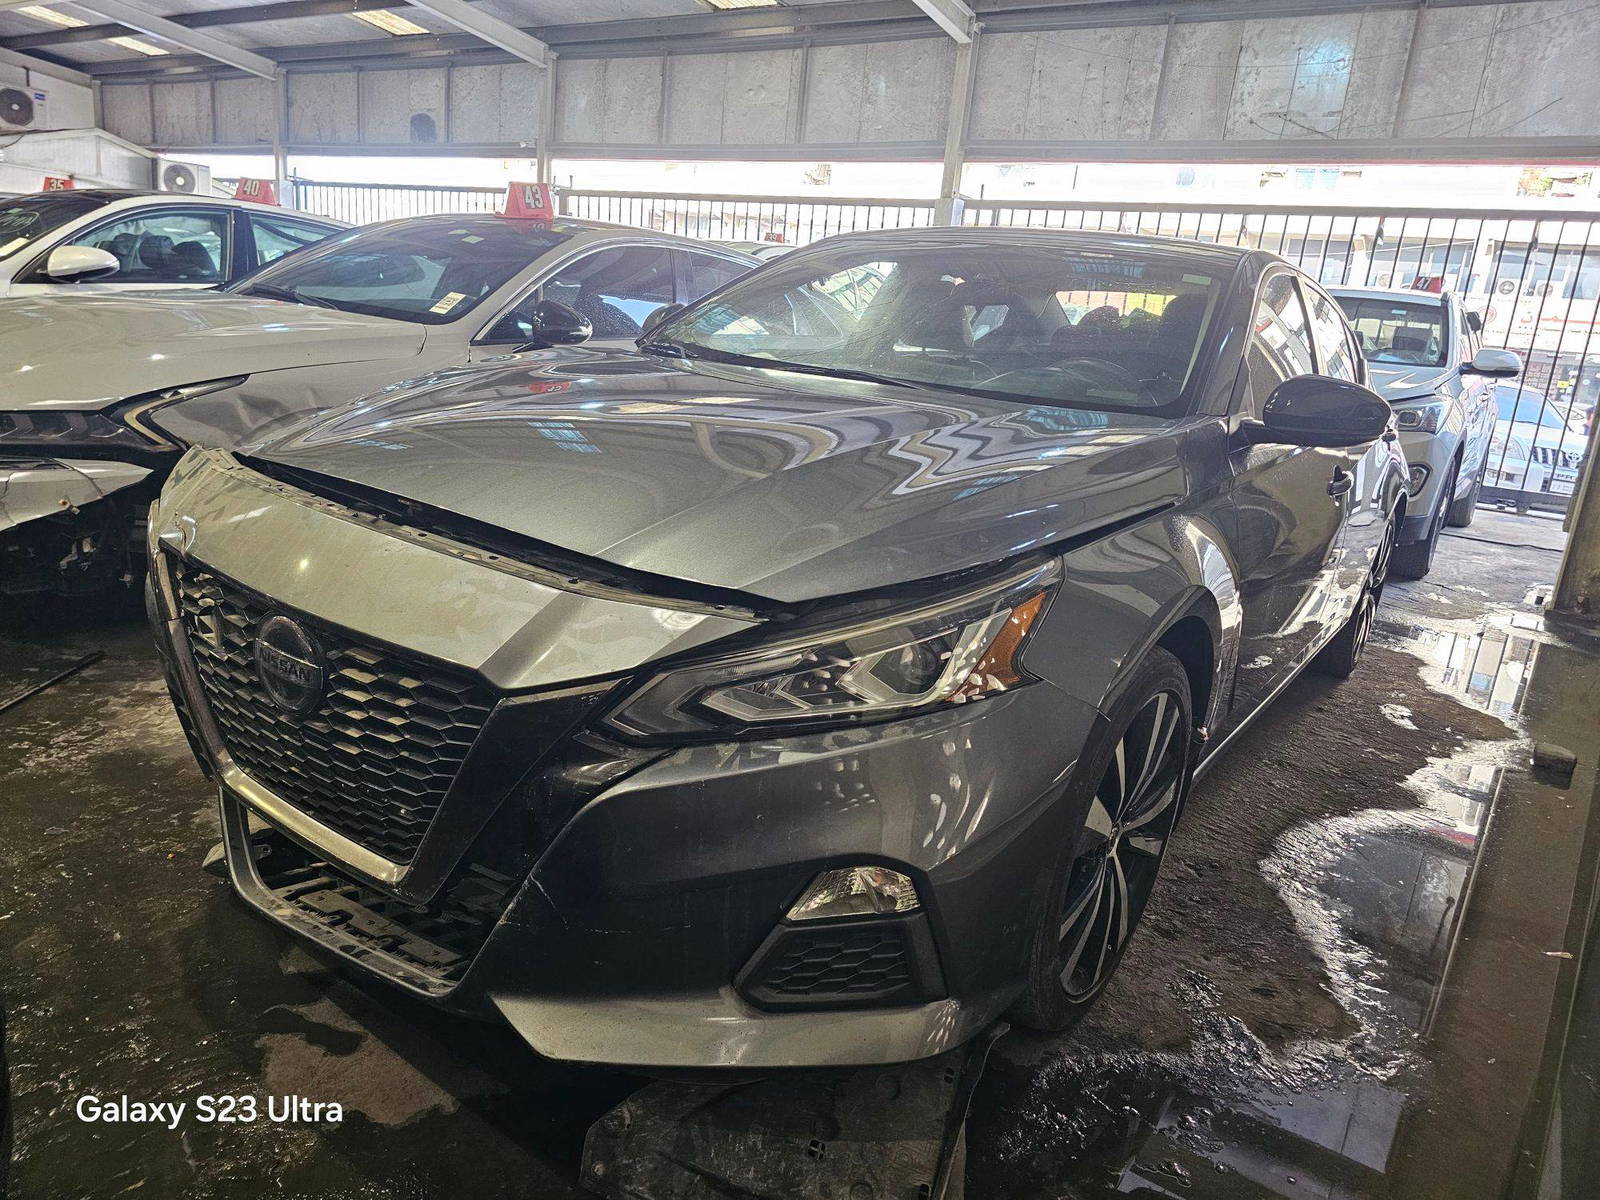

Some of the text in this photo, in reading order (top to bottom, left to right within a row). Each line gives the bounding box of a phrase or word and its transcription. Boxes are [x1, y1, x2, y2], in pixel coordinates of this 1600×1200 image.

[49, 178, 65, 191] 35
[243, 179, 260, 196] 40
[524, 184, 545, 209] 43
[1416, 277, 1432, 290] 47
[260, 646, 312, 682] NISSAN
